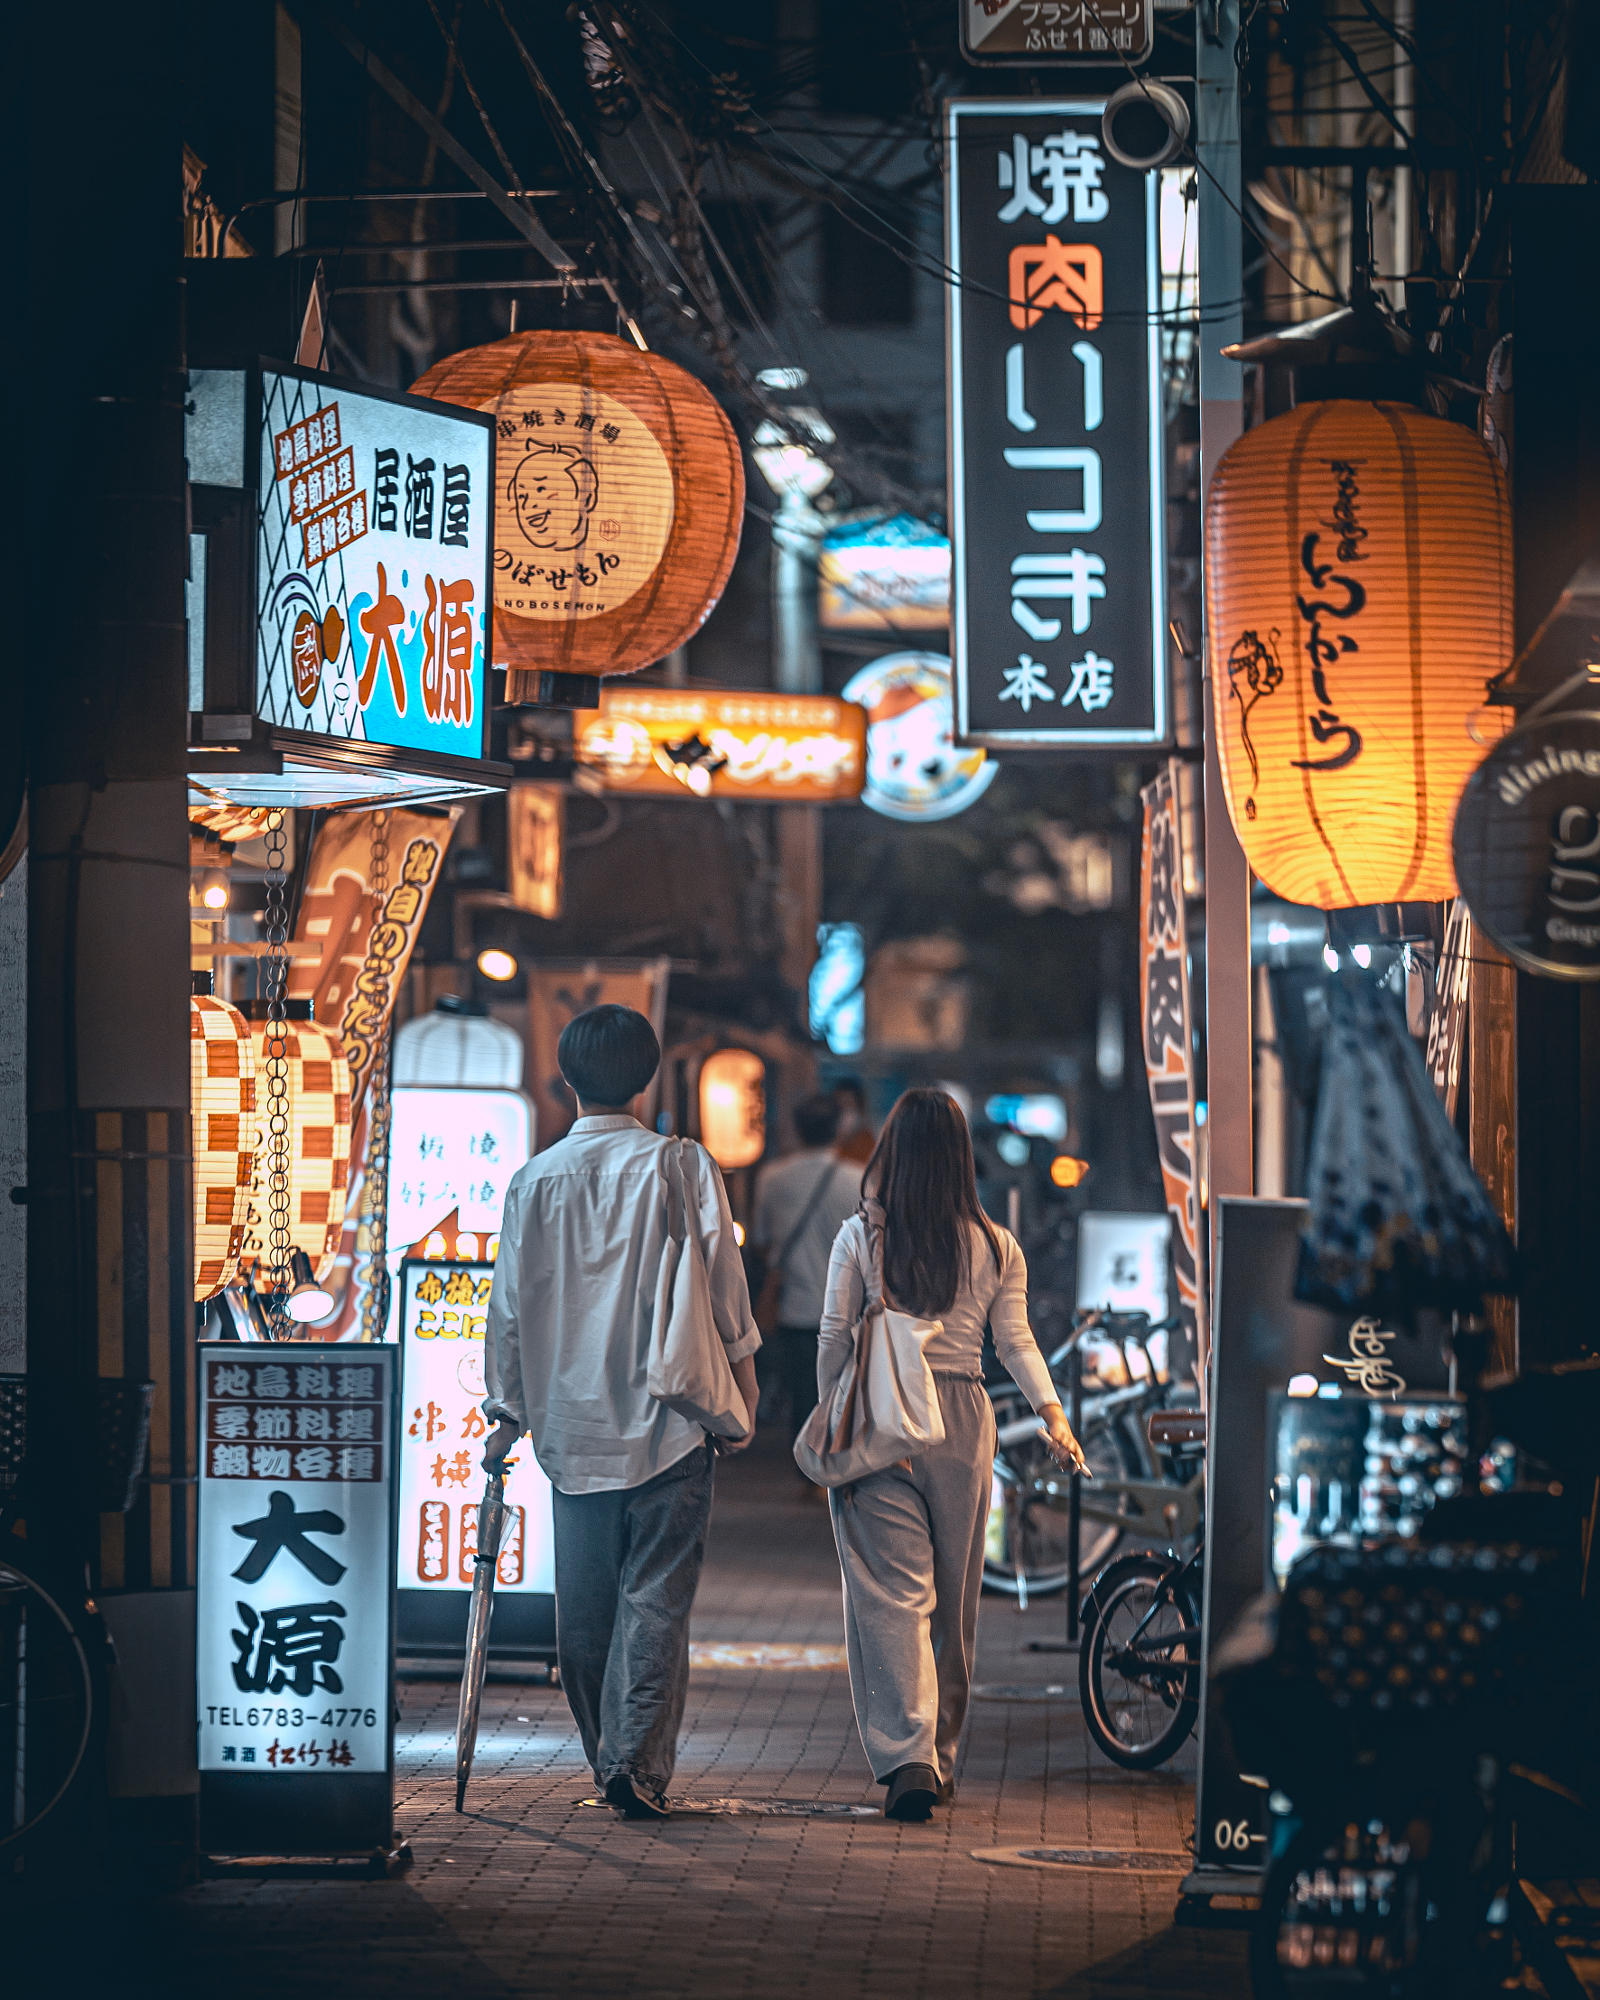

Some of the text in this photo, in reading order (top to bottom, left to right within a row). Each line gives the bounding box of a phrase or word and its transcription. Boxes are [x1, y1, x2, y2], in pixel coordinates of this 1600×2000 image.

[1025, 26, 1133, 51] ふせ1番街
[496, 407, 621, 444] 串焼き酒場
[371, 447, 472, 549] 居酒屋
[493, 551, 621, 591] のばせもん
[504, 599, 606, 612] NOBOSEMON
[358, 561, 476, 720] 大源
[998, 650, 1115, 713] 本店
[213, 1406, 375, 1440] 季節料理
[211, 1443, 375, 1480] 鍋物各種
[230, 1490, 348, 1697] 大源
[266, 1737, 355, 1768] 松竹梅
